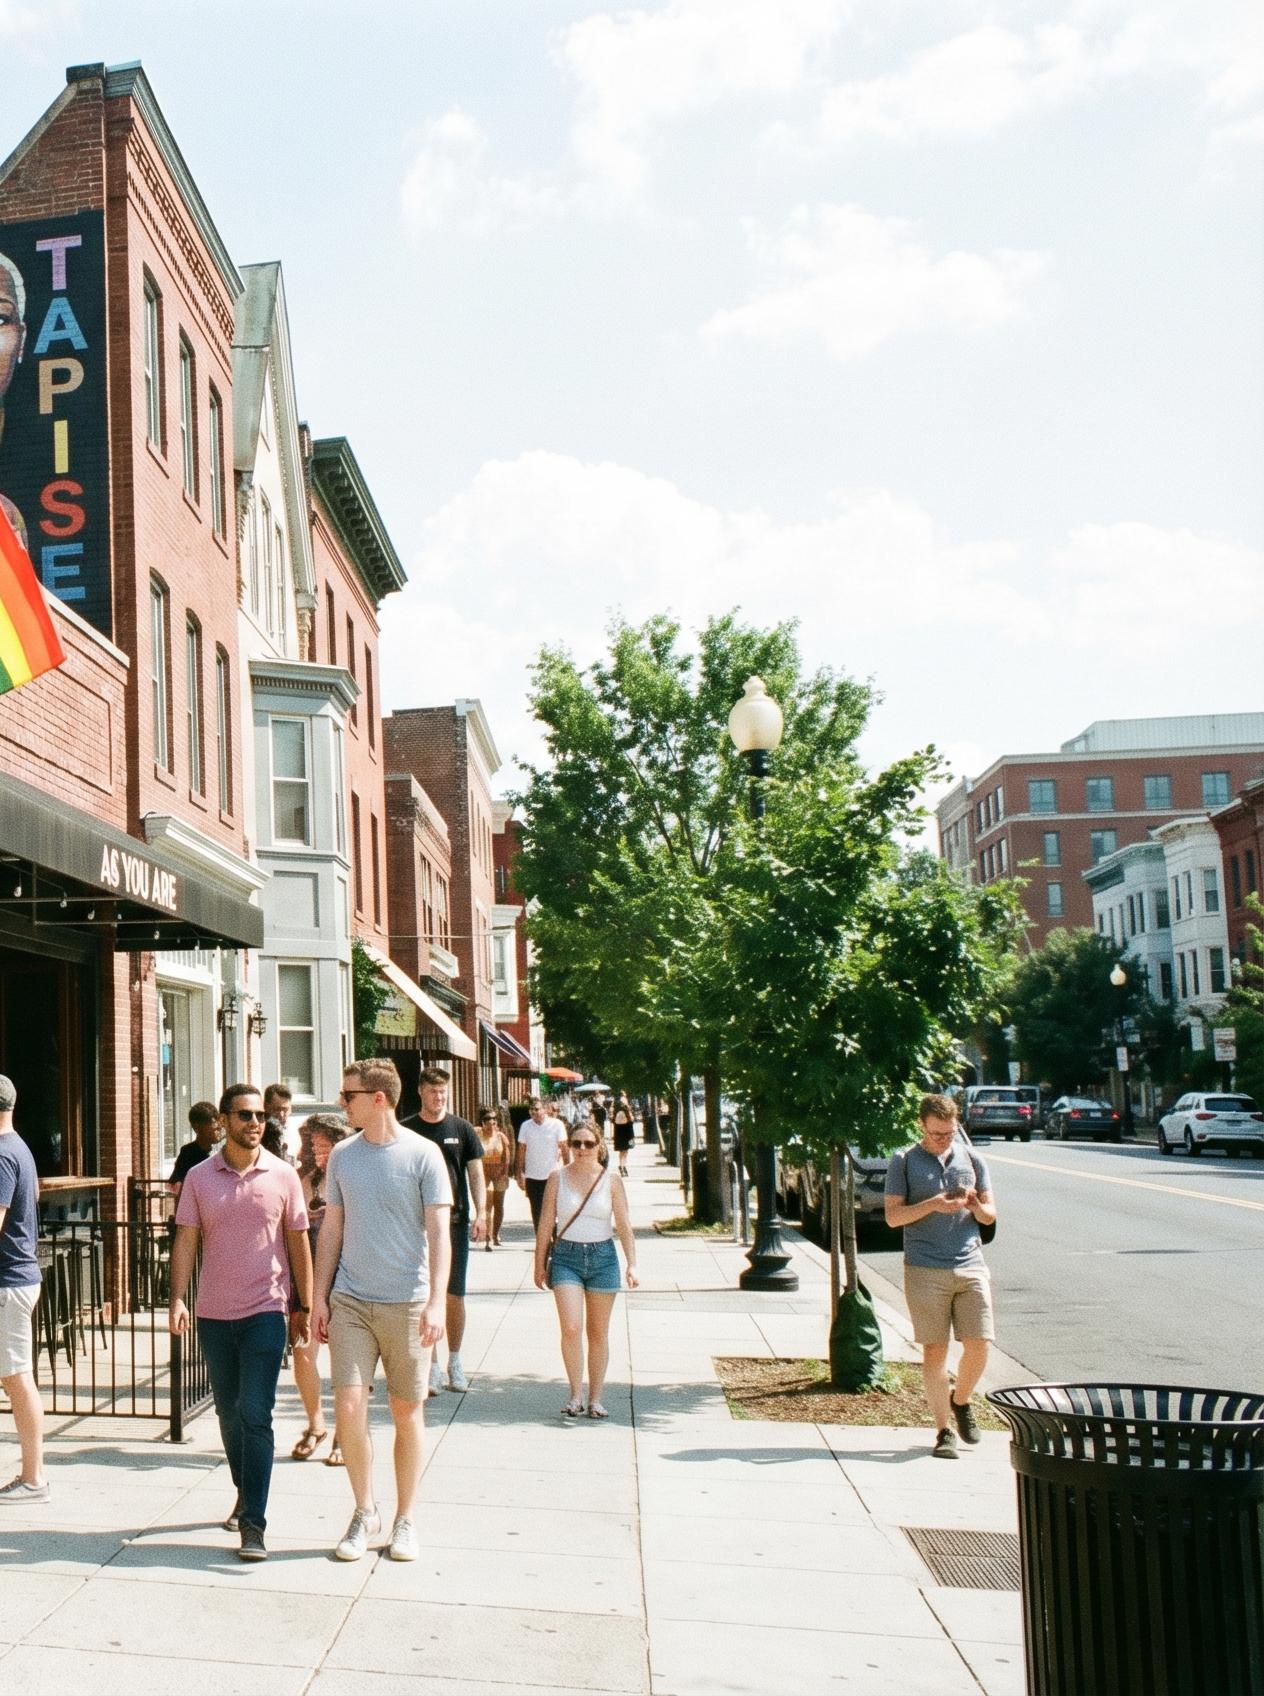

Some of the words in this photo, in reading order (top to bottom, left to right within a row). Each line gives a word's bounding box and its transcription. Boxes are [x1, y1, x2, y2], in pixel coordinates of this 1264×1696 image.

[33, 234, 89, 601] TAPISE
[100, 844, 120, 888] AS
[121, 851, 149, 900] YOU
[151, 866, 177, 911] ARE
